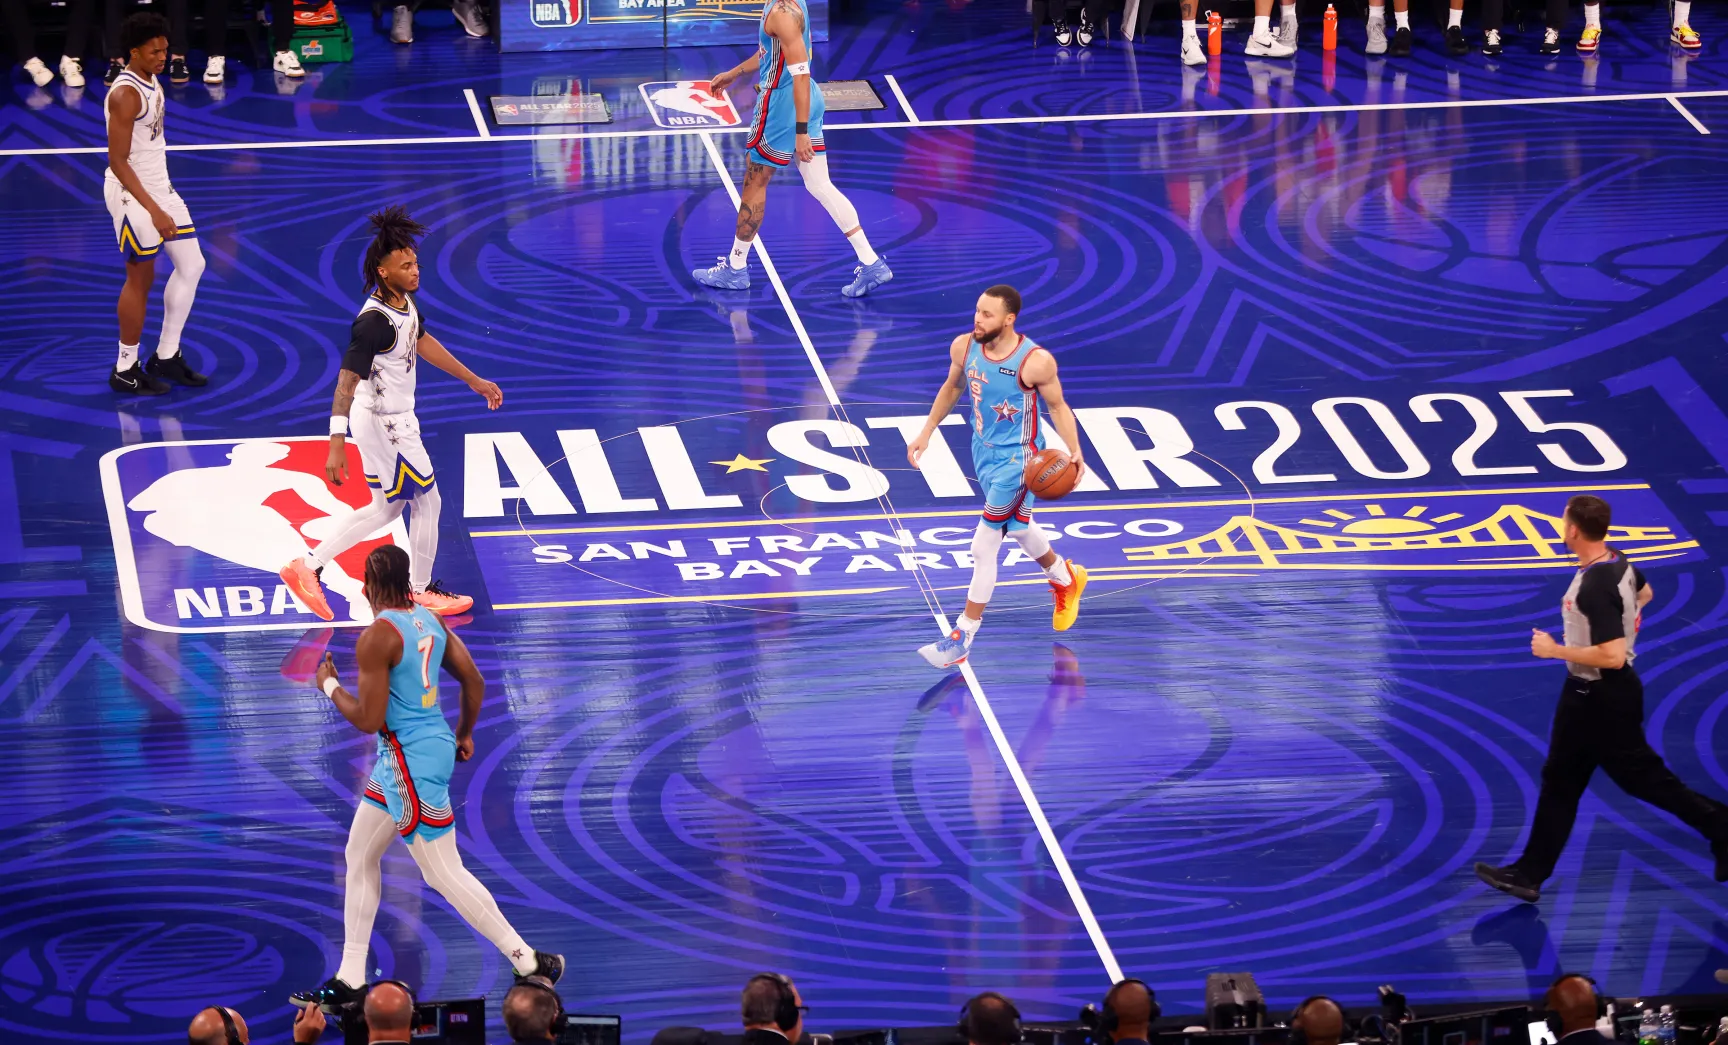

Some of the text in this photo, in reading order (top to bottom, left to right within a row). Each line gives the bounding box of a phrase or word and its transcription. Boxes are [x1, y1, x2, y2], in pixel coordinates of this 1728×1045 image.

[535, 3, 560, 21] NBA
[618, 0, 644, 8] BAY
[822, 89, 842, 97] TAR
[667, 116, 710, 125] NBA
[967, 368, 990, 385] ALL
[463, 426, 744, 518] ALL
[1214, 389, 1628, 485] 2025
[531, 518, 1184, 563] SAN FRANCSCO
[674, 557, 823, 581] BAY
[173, 584, 313, 619] NBA
[417, 635, 434, 689] 7
